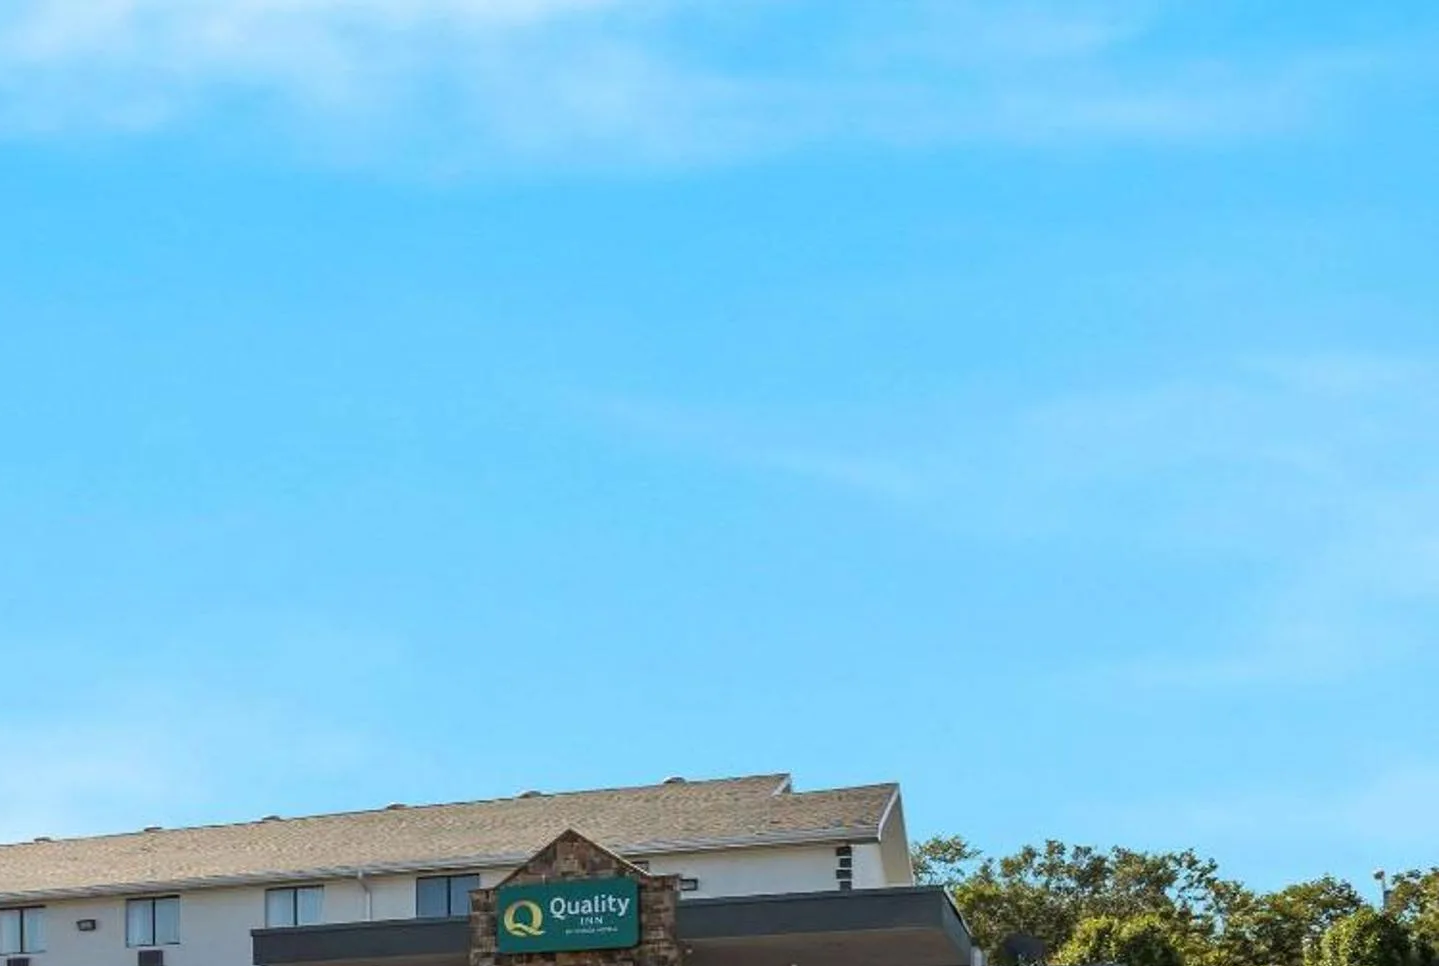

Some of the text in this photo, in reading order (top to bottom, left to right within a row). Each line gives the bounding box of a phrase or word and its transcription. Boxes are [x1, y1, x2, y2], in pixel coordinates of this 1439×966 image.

[503, 899, 546, 937] Q
[549, 894, 630, 920] Quality
[580, 916, 603, 925] INN
